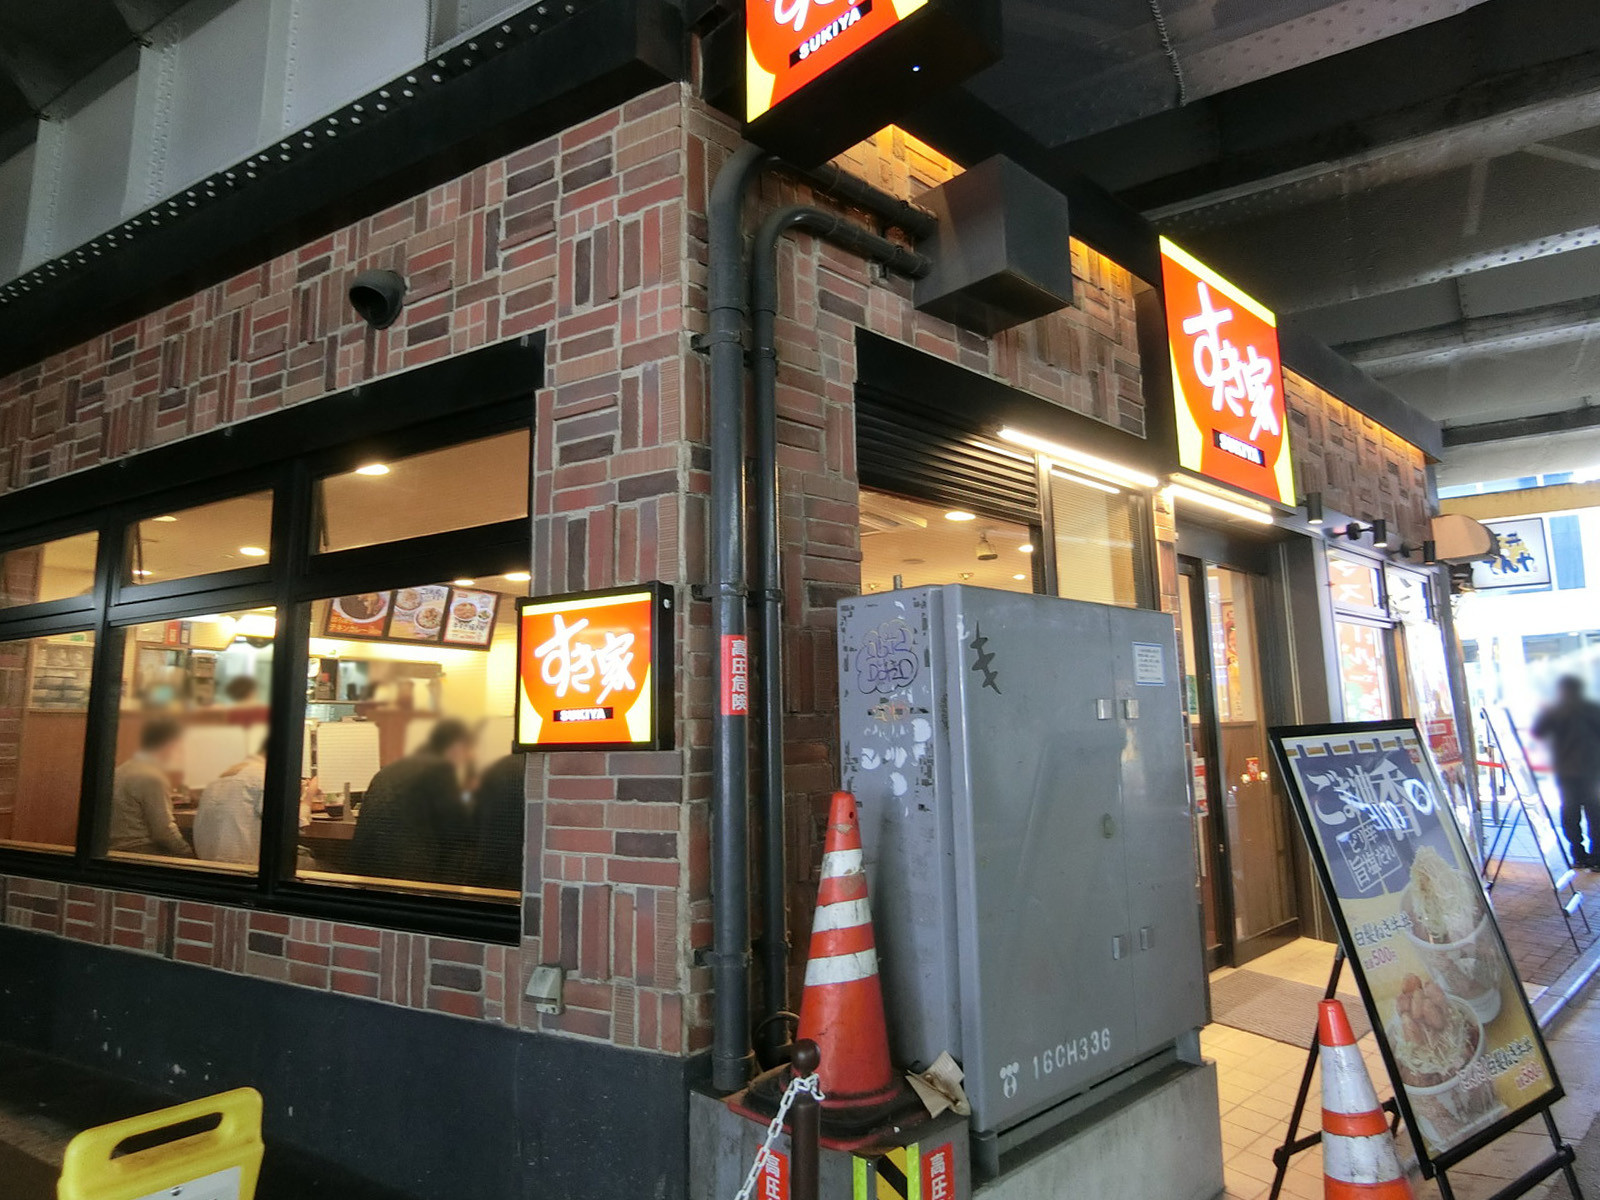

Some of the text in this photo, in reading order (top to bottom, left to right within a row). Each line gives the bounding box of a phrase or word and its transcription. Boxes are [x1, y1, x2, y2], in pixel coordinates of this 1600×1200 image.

[798, 6, 861, 60] SUKIYA
[1182, 281, 1280, 442] すき家
[534, 613, 636, 705] すき家
[731, 638, 747, 711] 高圧危険
[1033, 1027, 1111, 1080] 16CH336
